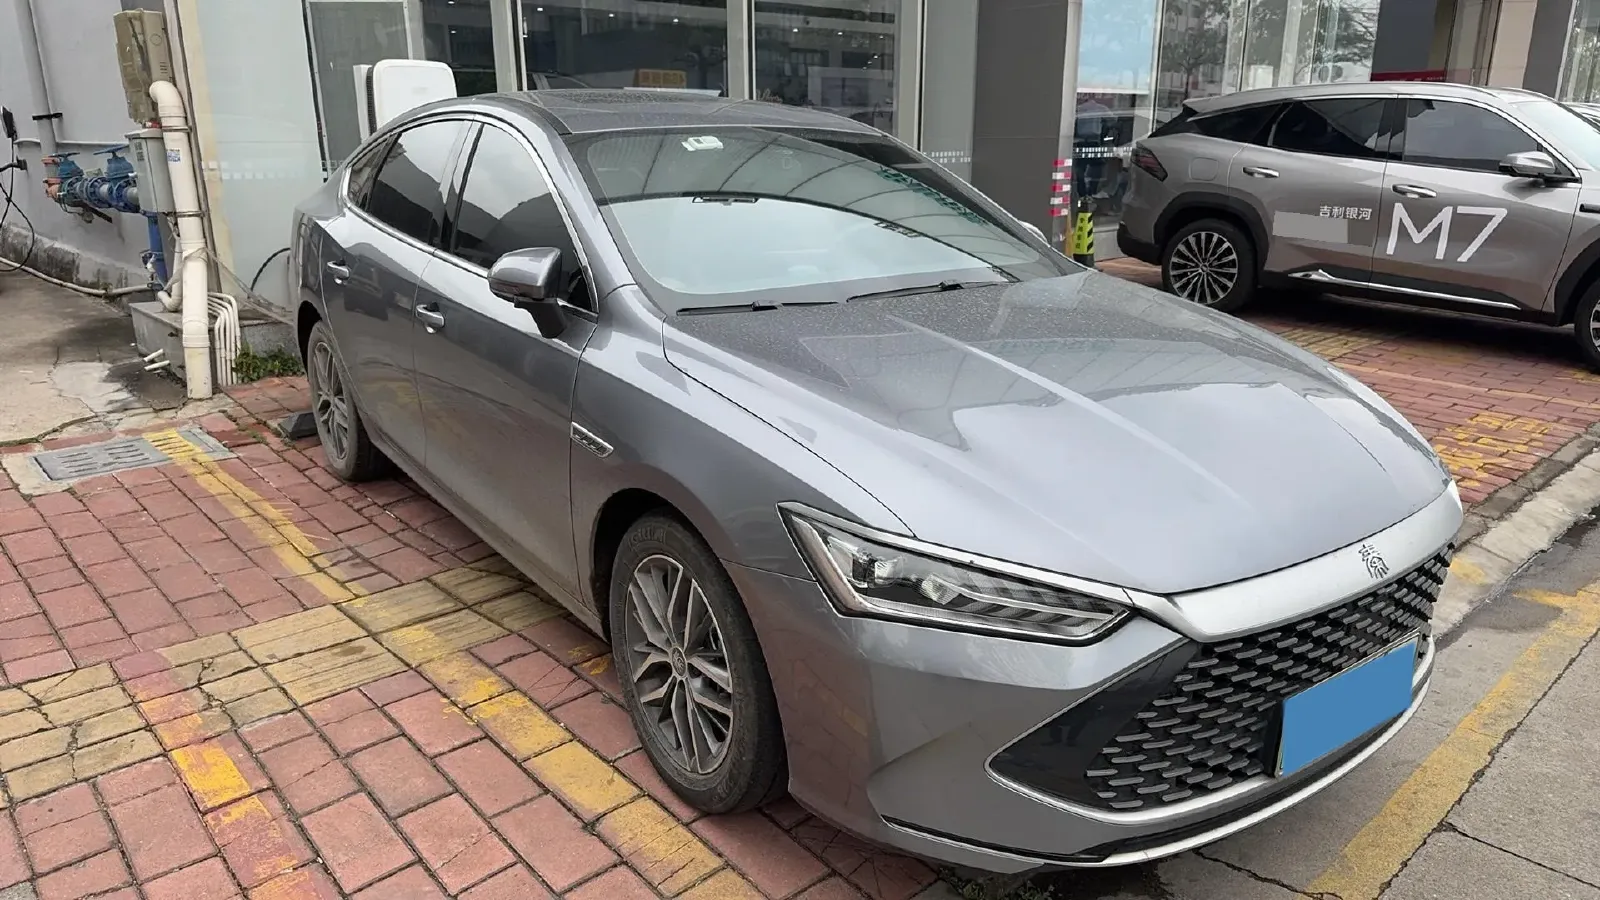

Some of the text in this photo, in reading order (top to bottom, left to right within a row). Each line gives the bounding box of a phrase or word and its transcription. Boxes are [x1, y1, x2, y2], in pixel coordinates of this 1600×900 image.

[1319, 205, 1372, 220] 吉利银河
[1386, 202, 1508, 262] M7
